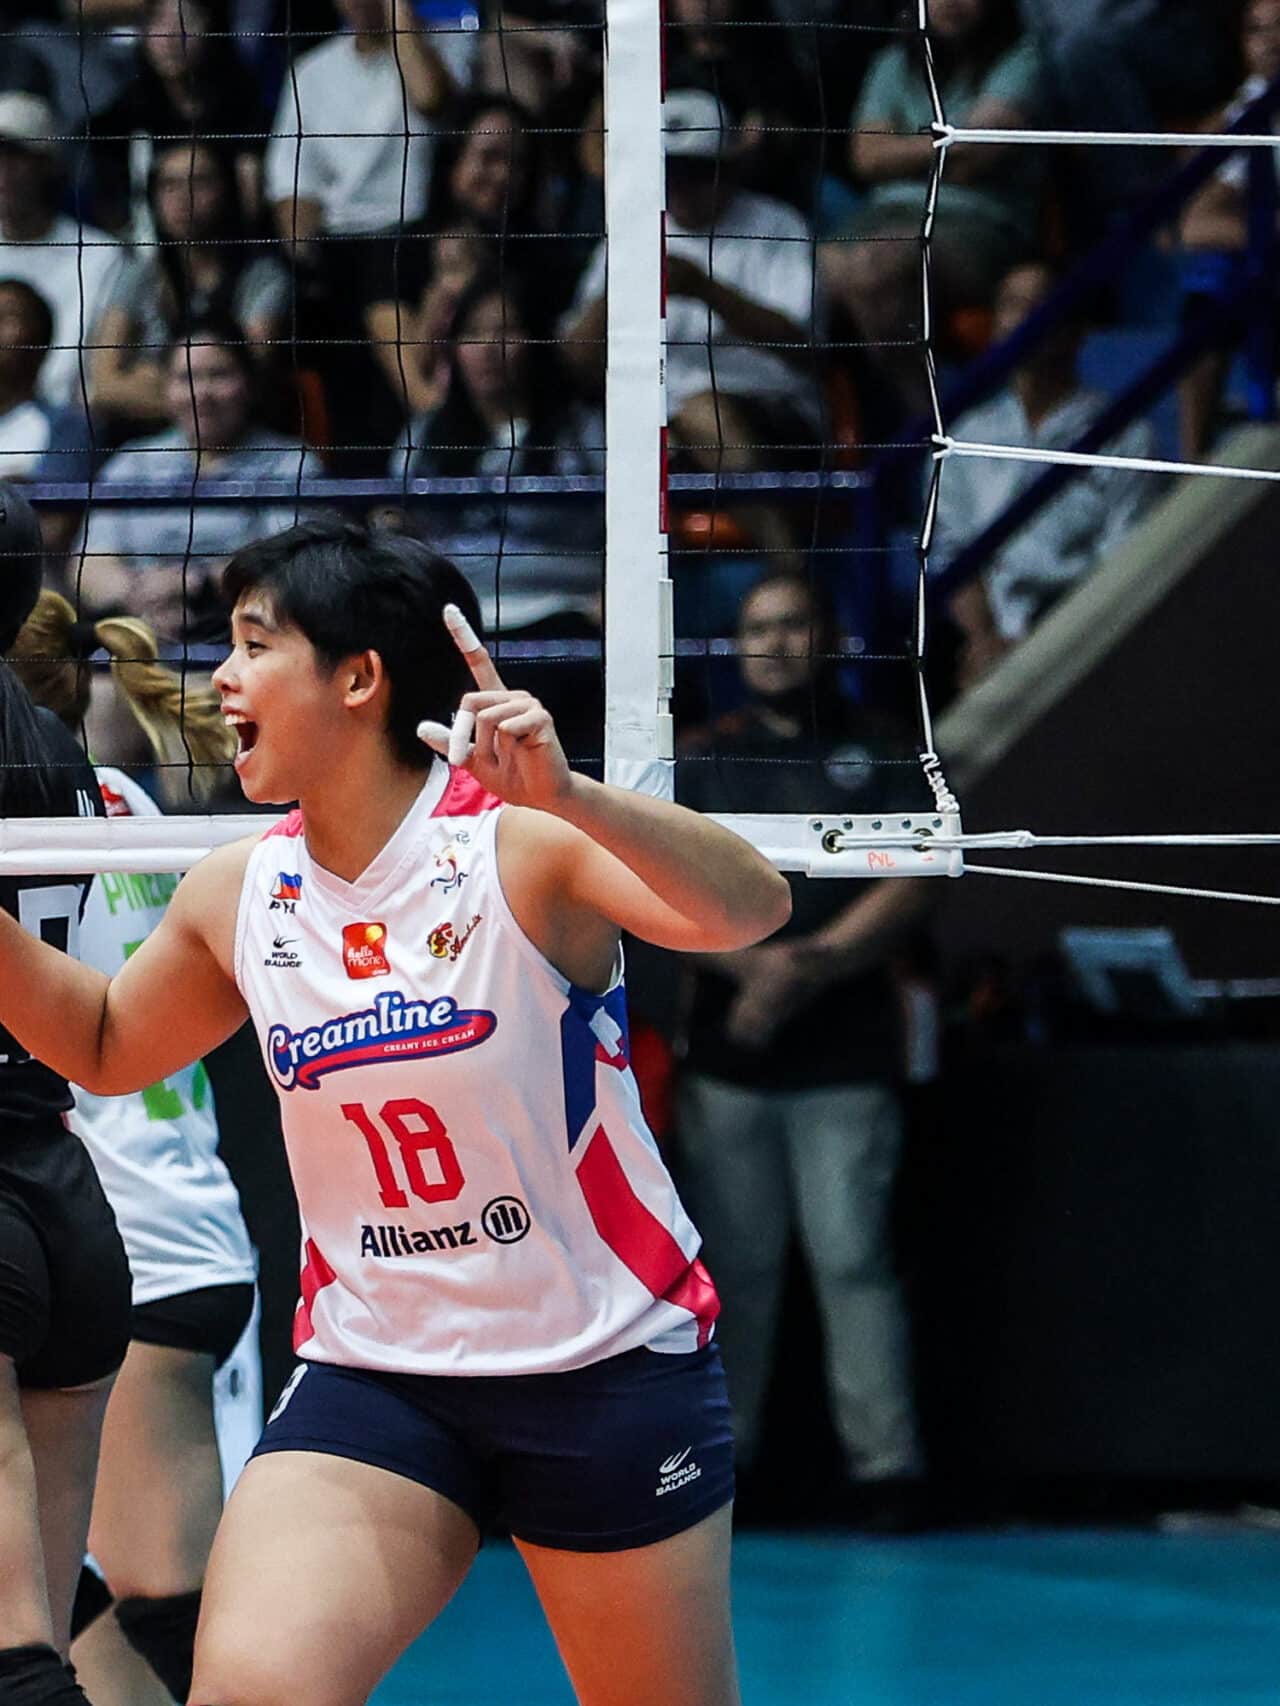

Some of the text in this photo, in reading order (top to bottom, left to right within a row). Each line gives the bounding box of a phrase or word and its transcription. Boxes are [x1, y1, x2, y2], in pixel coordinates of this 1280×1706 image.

[867, 850, 896, 871] PVL
[269, 996, 454, 1087] Creamline
[383, 1029, 476, 1053] CREAMY ICE CREAM
[340, 1097, 466, 1208] 18
[360, 1221, 478, 1258] Allianz
[655, 1466, 703, 1497] BALANCE
[660, 1462, 696, 1486] WORLD
